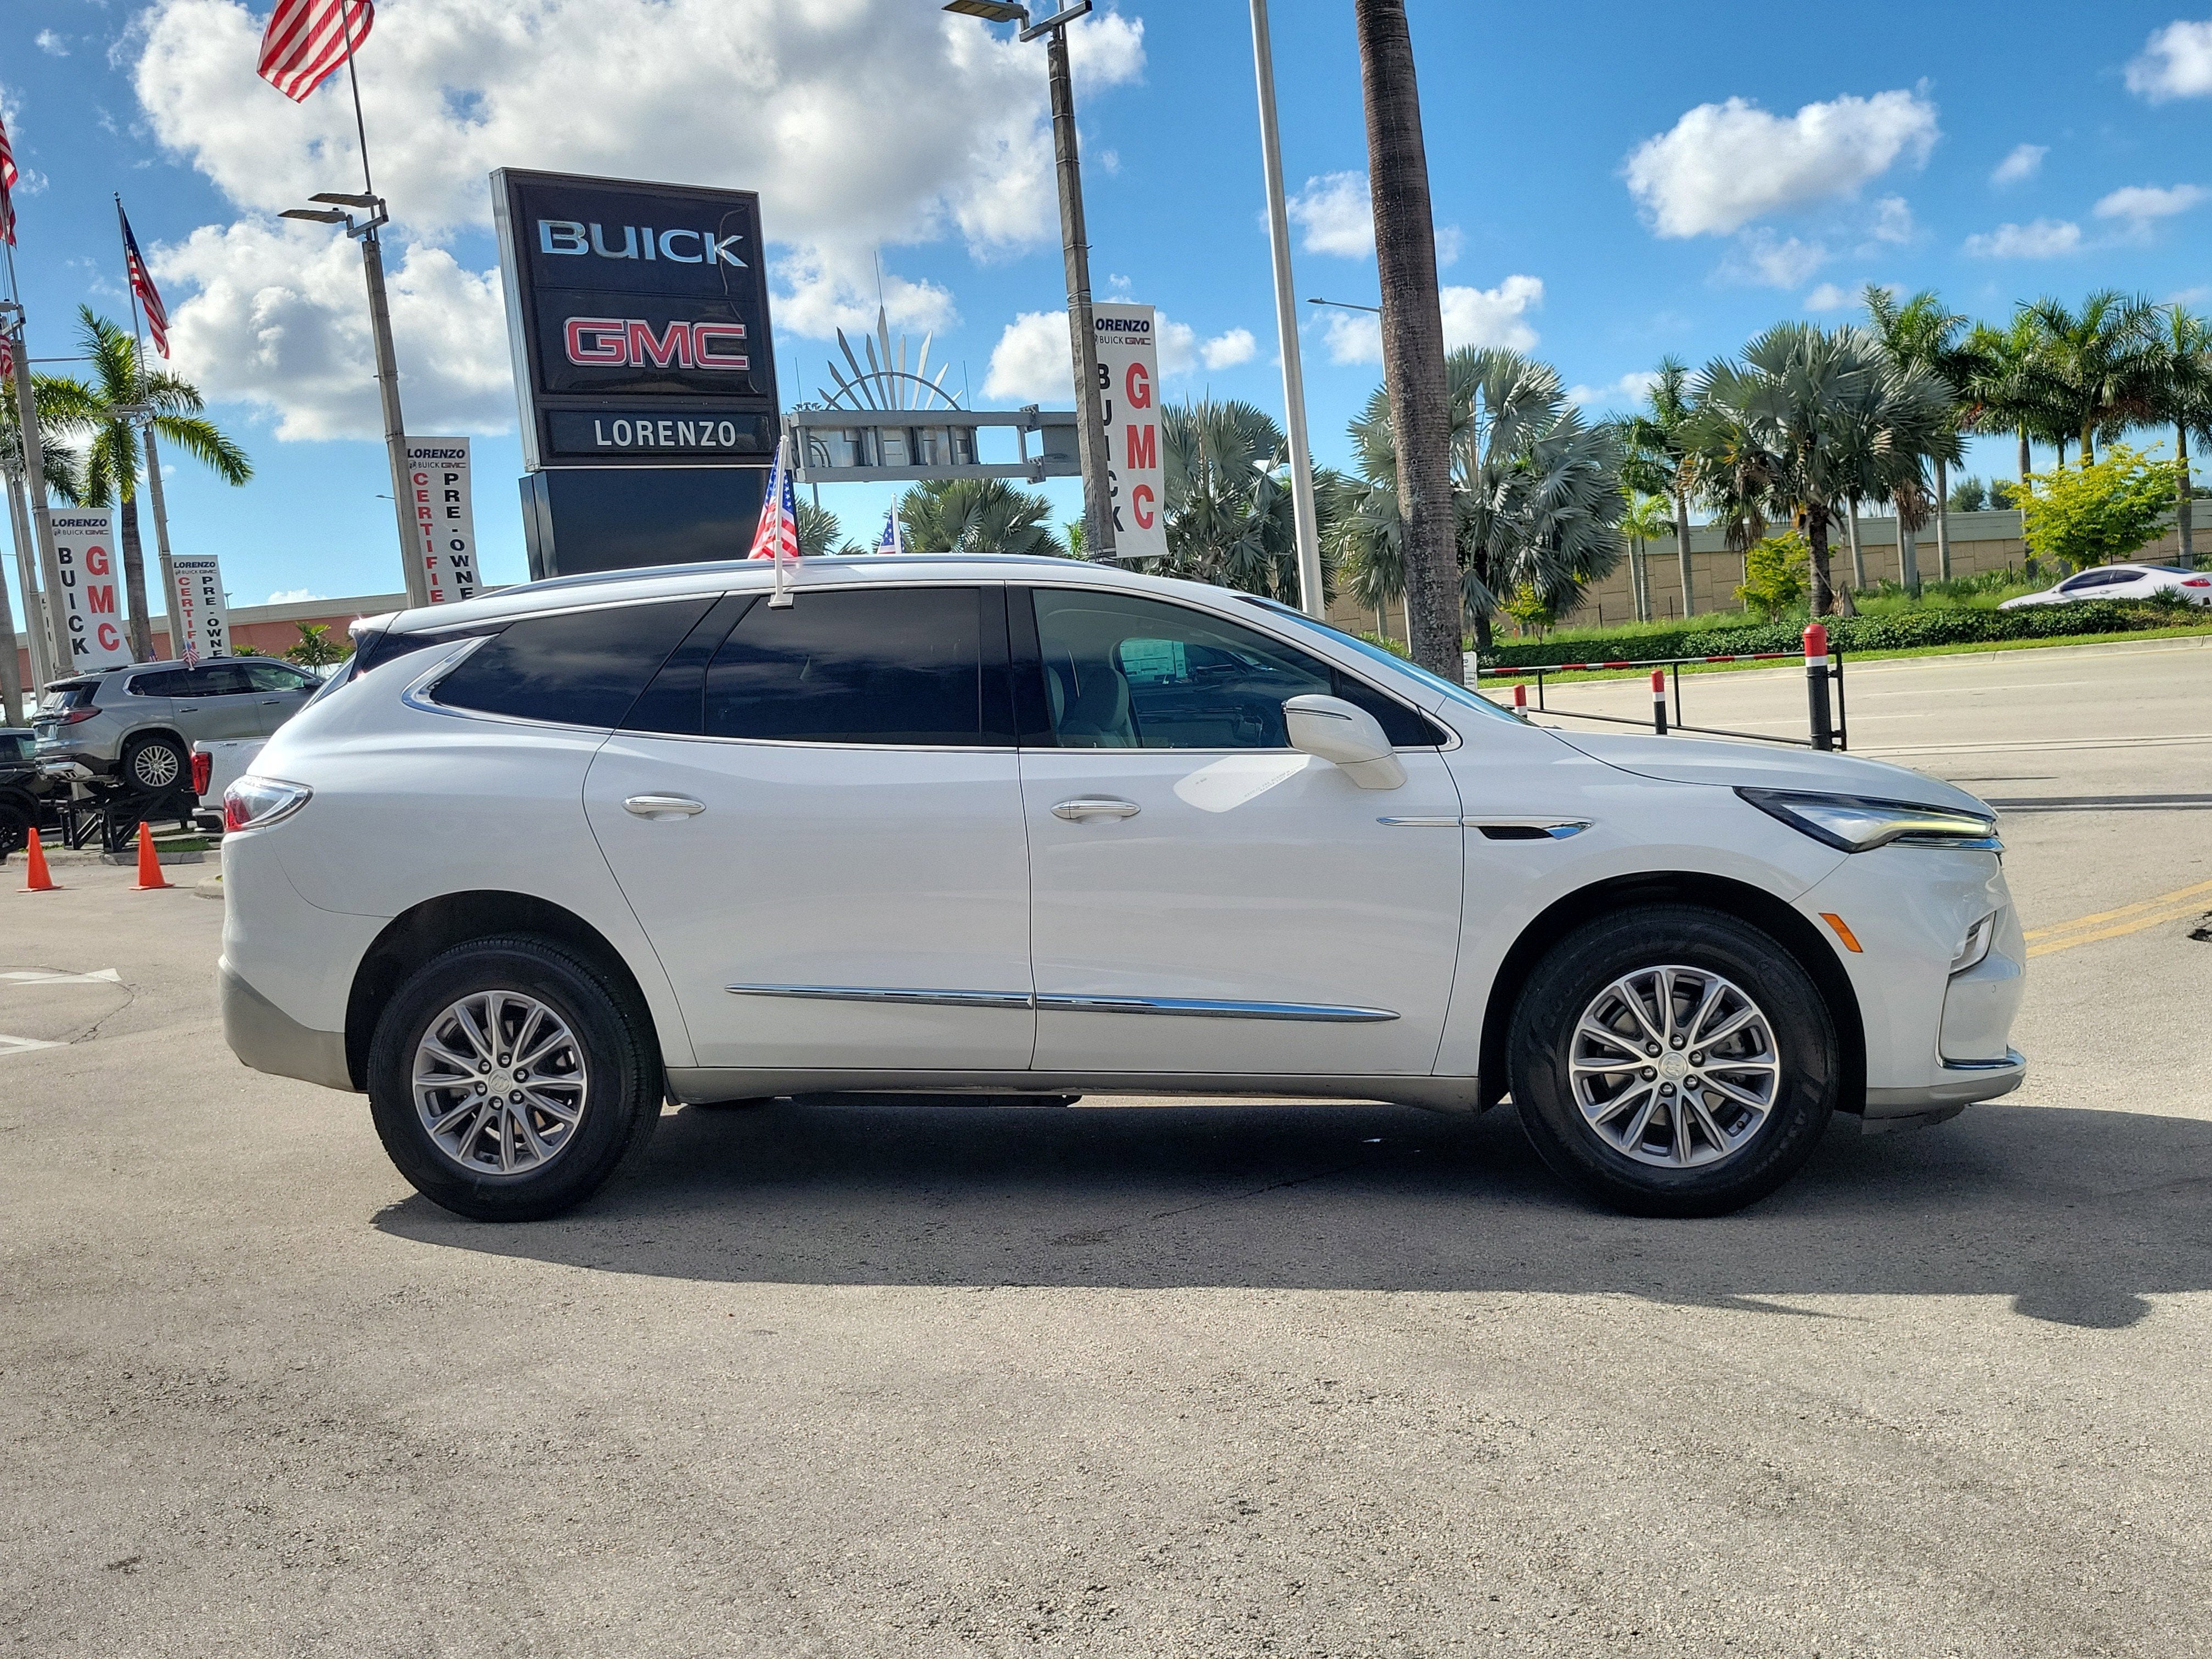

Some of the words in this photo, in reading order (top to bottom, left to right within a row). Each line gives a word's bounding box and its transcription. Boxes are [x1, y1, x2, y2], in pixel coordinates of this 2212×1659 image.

[538, 220, 748, 267] BUICK
[564, 317, 751, 370] GMC
[1096, 318, 1150, 332] ORENZO
[1100, 336, 1124, 345] BUICK
[407, 448, 465, 459] LORENZO
[595, 420, 736, 447] LORENZO
[1126, 362, 1156, 530] GMC
[52, 518, 108, 527] LORENZO
[413, 472, 445, 602] CERTIFIE
[444, 473, 475, 600] PRE-OWNE
[58, 547, 91, 656] BUICK
[86, 545, 120, 651] GMC
[178, 577, 197, 650] CERTIFI
[202, 576, 222, 656] PRE-OWNE
